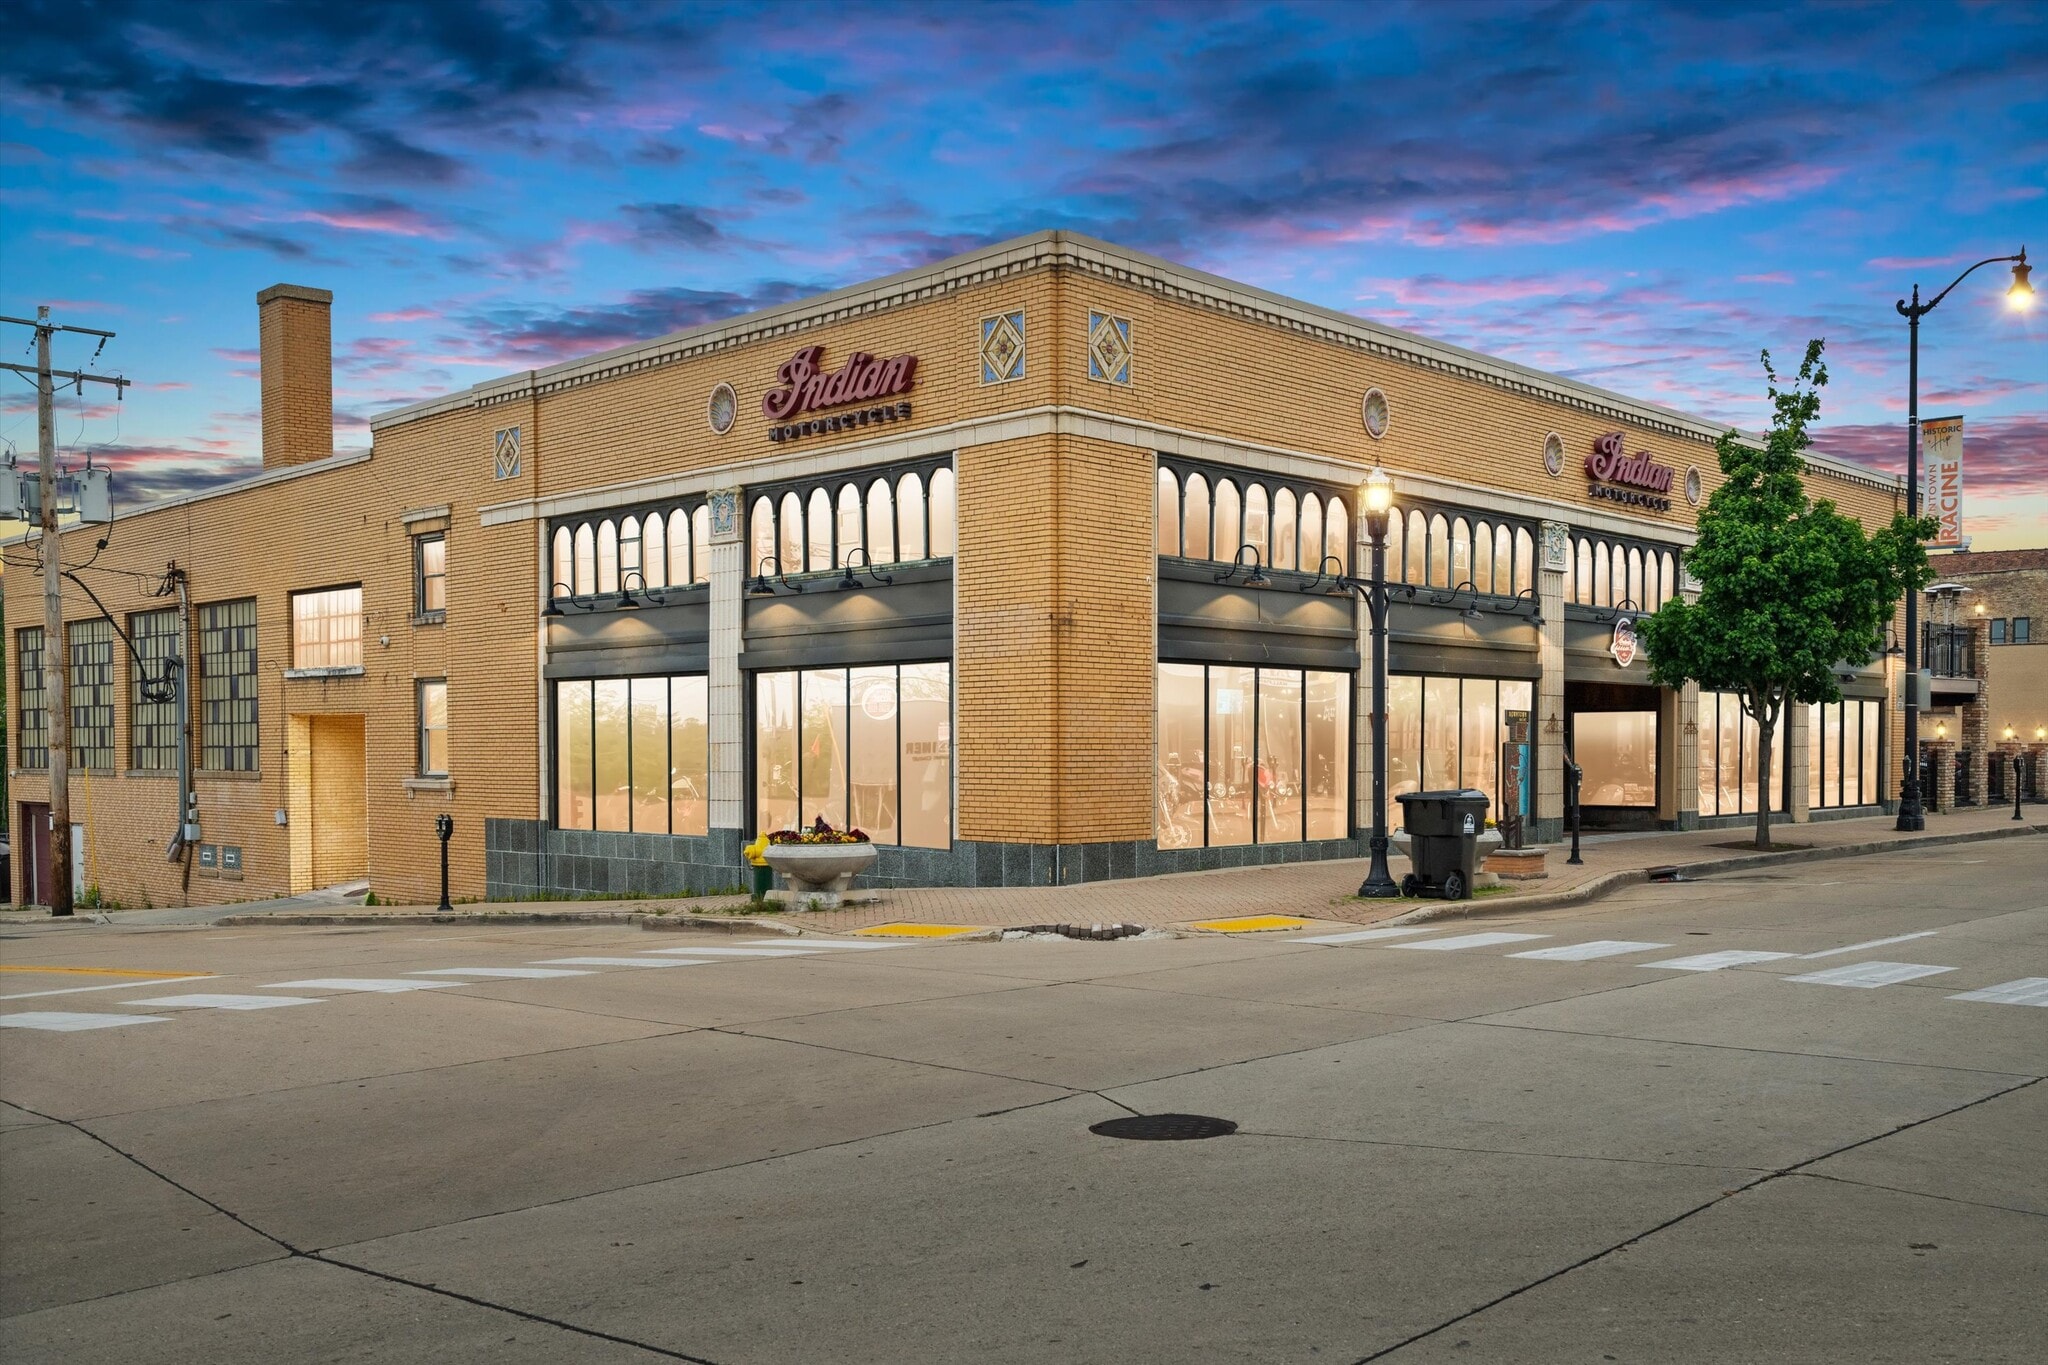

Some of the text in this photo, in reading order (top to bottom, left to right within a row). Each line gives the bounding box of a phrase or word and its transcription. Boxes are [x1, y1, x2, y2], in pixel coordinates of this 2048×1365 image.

[762, 346, 918, 419] Indian
[769, 403, 912, 442] MOTORCYCLE
[1923, 425, 1962, 436] HISTORIC
[1585, 431, 1674, 493] Indian
[1590, 484, 1672, 511] MOTORCYCLE
[1940, 461, 1958, 540] RACINE
